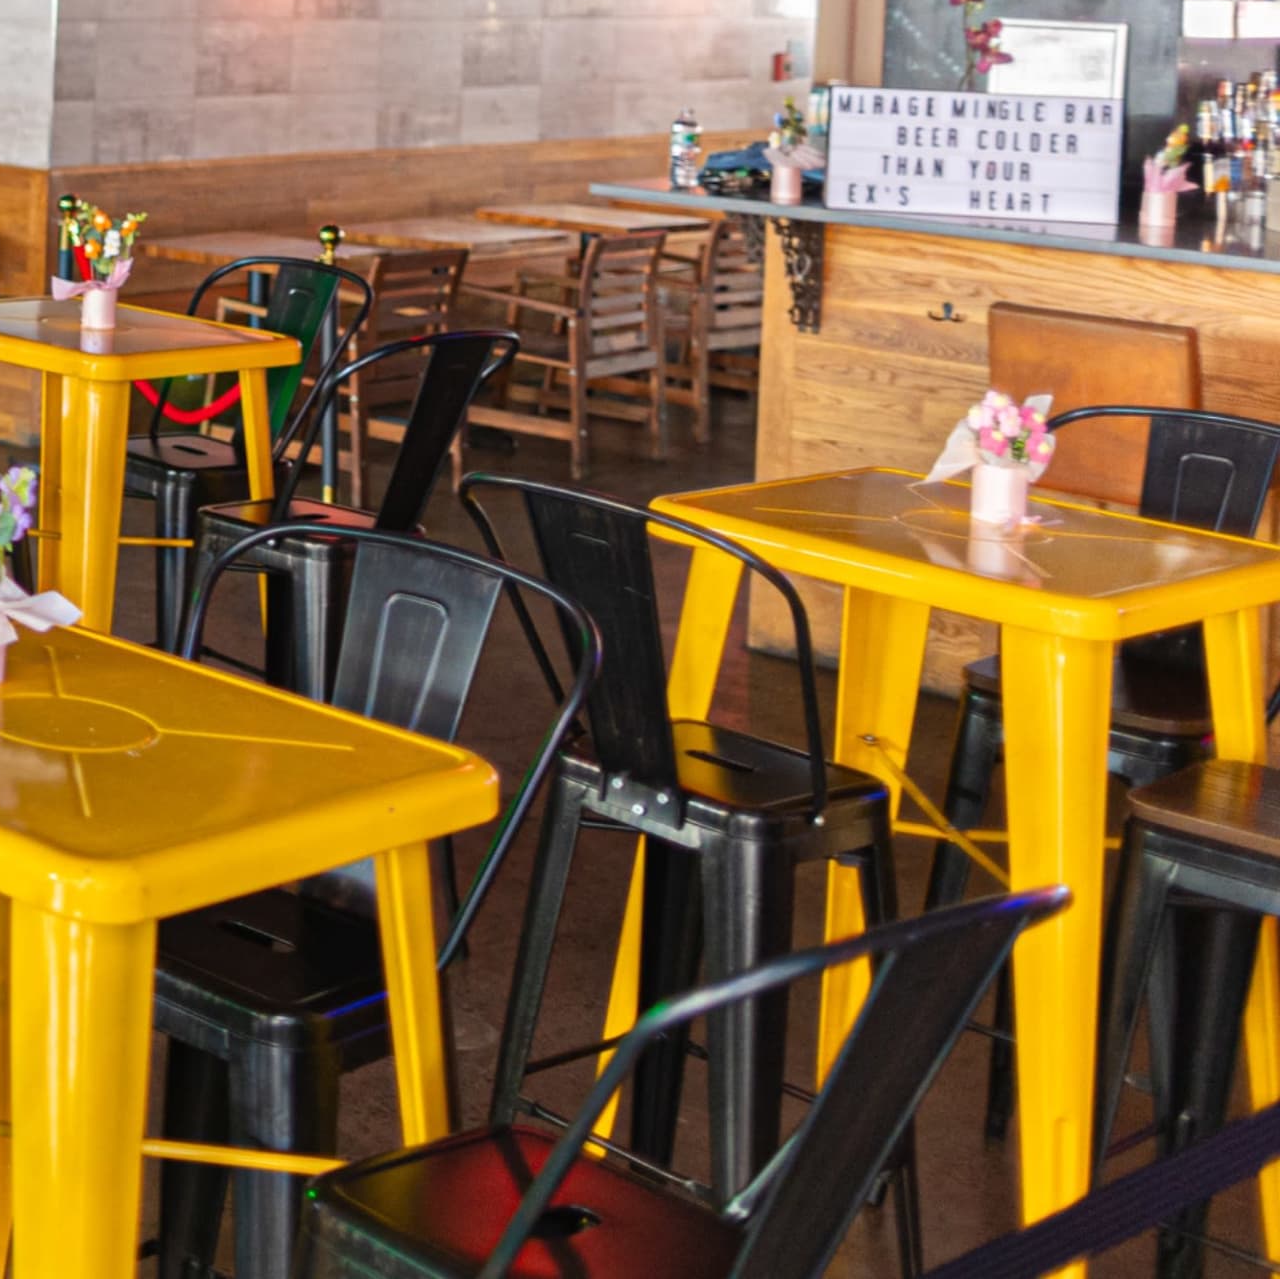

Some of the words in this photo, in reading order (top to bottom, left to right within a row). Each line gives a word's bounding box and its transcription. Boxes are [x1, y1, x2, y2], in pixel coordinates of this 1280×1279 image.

[838, 94, 935, 118] MIRAGE
[952, 99, 1046, 122] MINGLE
[1065, 103, 1113, 125] BAR
[896, 126, 959, 148] BEER
[977, 130, 1079, 154] COLDER
[882, 155, 945, 178] THAN
[969, 160, 1031, 182] YOUR
[848, 183, 910, 207] EX'S
[969, 191, 1052, 213] HEART
